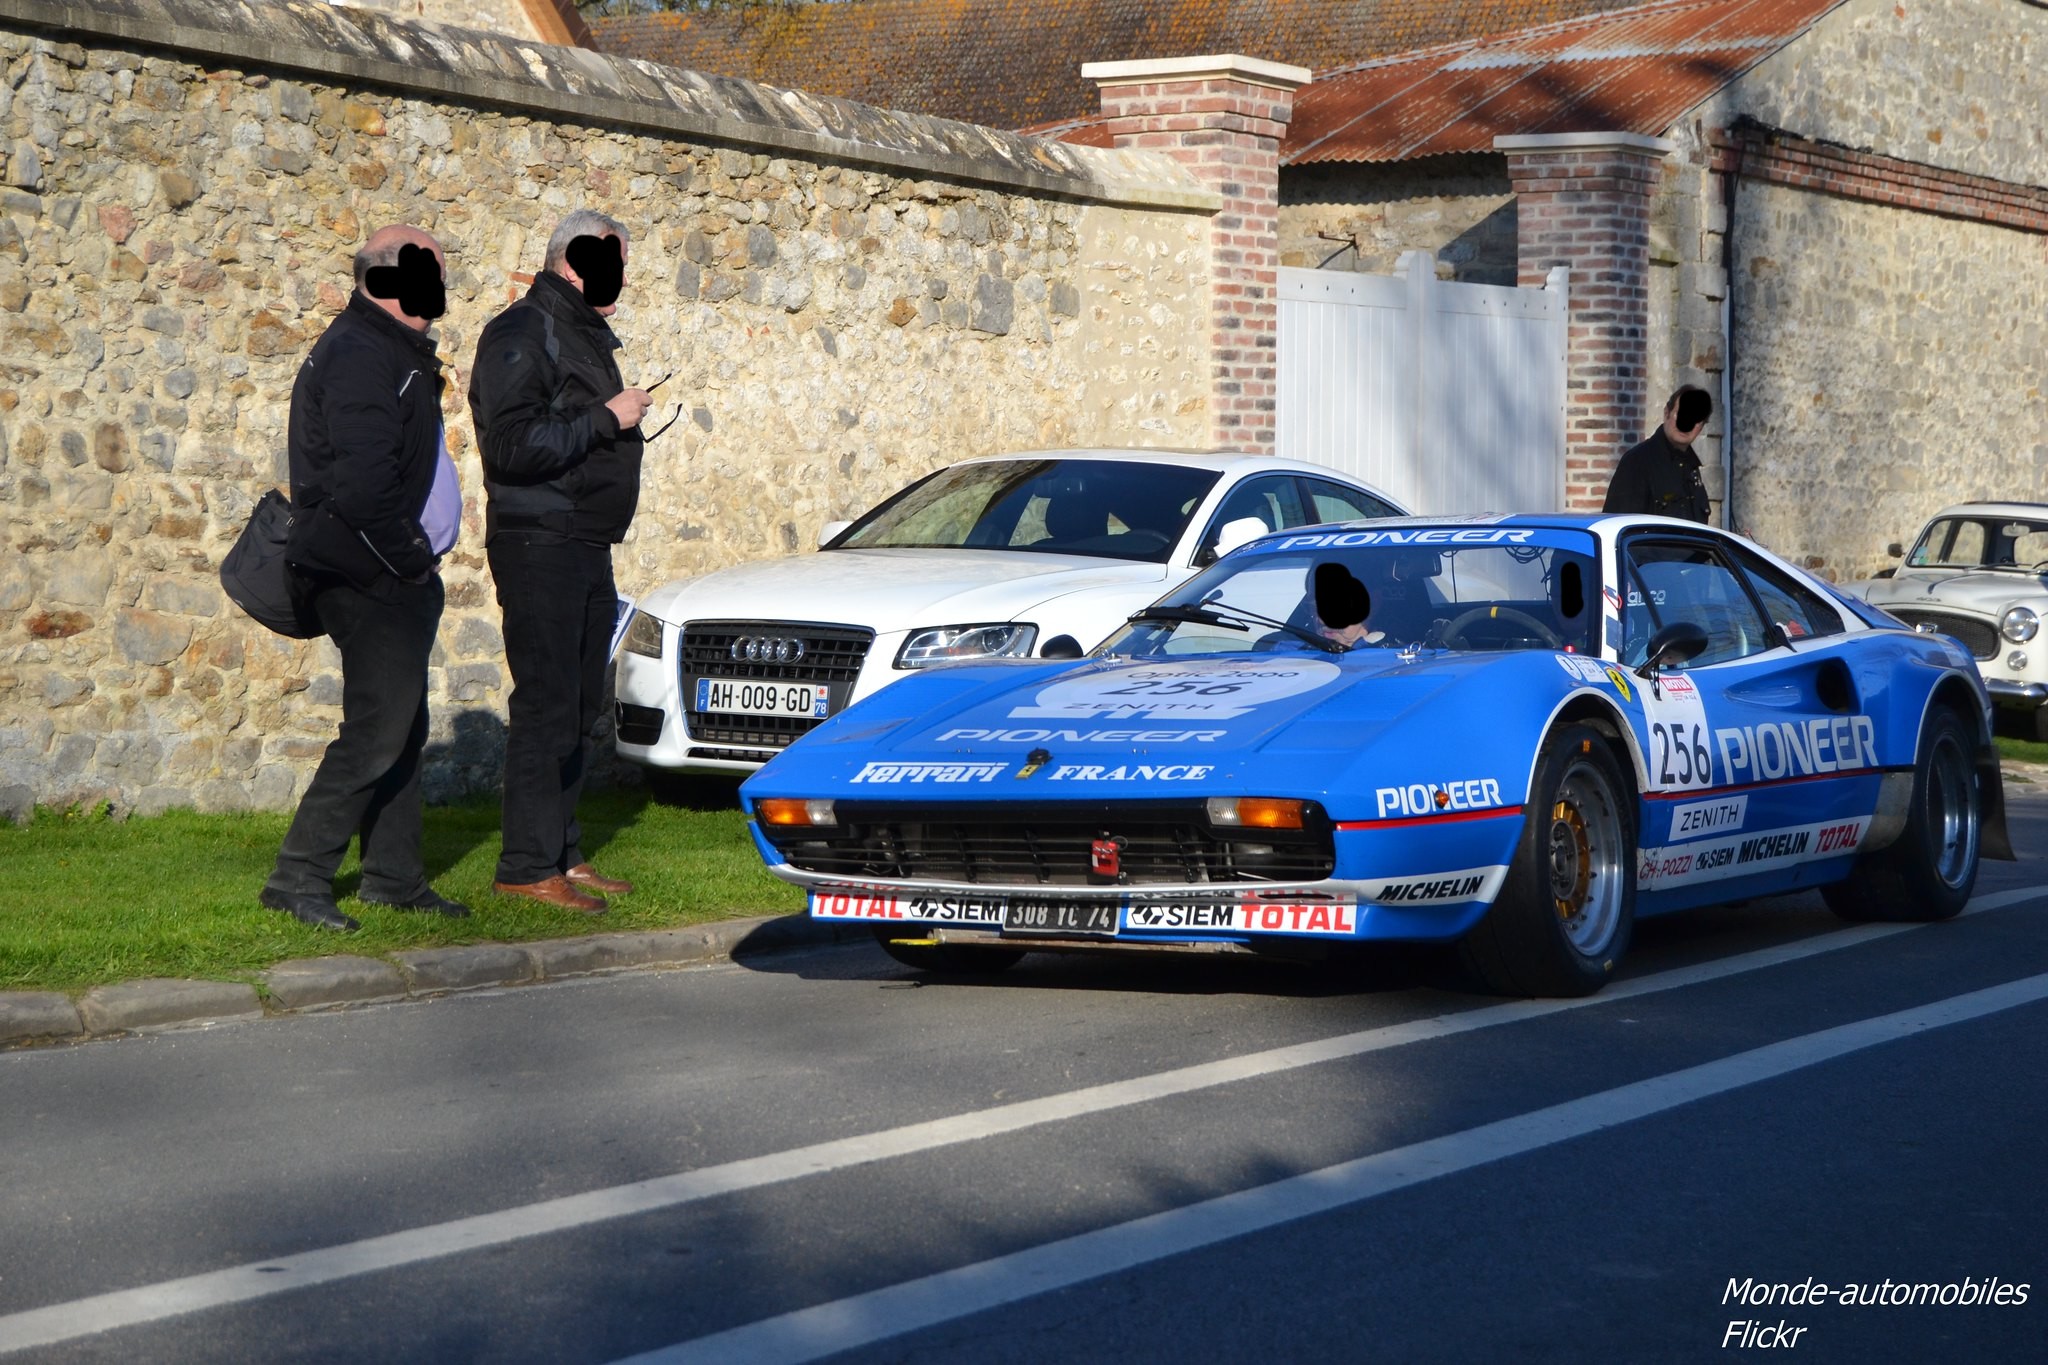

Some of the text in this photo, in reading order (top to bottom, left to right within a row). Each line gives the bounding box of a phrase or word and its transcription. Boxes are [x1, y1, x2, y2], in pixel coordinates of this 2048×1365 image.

[1277, 528, 1536, 549] PIONEER
[1128, 670, 1300, 680] Optic 2000
[1663, 678, 1690, 690] MOTUL
[710, 683, 811, 712] AH-009-GD
[1100, 681, 1253, 695] 256
[815, 701, 827, 714] 78
[1065, 703, 1216, 711] ZENITH
[935, 728, 1228, 743] PIONEER
[1652, 722, 1711, 784] 256
[1715, 715, 1879, 784] PIONEER
[849, 761, 1010, 784] Ferrari
[1047, 765, 1216, 782] FRANCE
[1376, 778, 1503, 817] PIONEER
[1679, 804, 1740, 831] ZENITH
[1708, 846, 1735, 868] SIEM
[1737, 831, 1810, 864] MICHELIN
[1815, 822, 1861, 854] TOTAL
[1376, 875, 1485, 901] MICHELIN
[813, 893, 1003, 921] TOTAL SIEM
[1012, 903, 1048, 925] 308
[1086, 905, 1110, 927] 74
[1167, 905, 1352, 931] SIEM TOTAL
